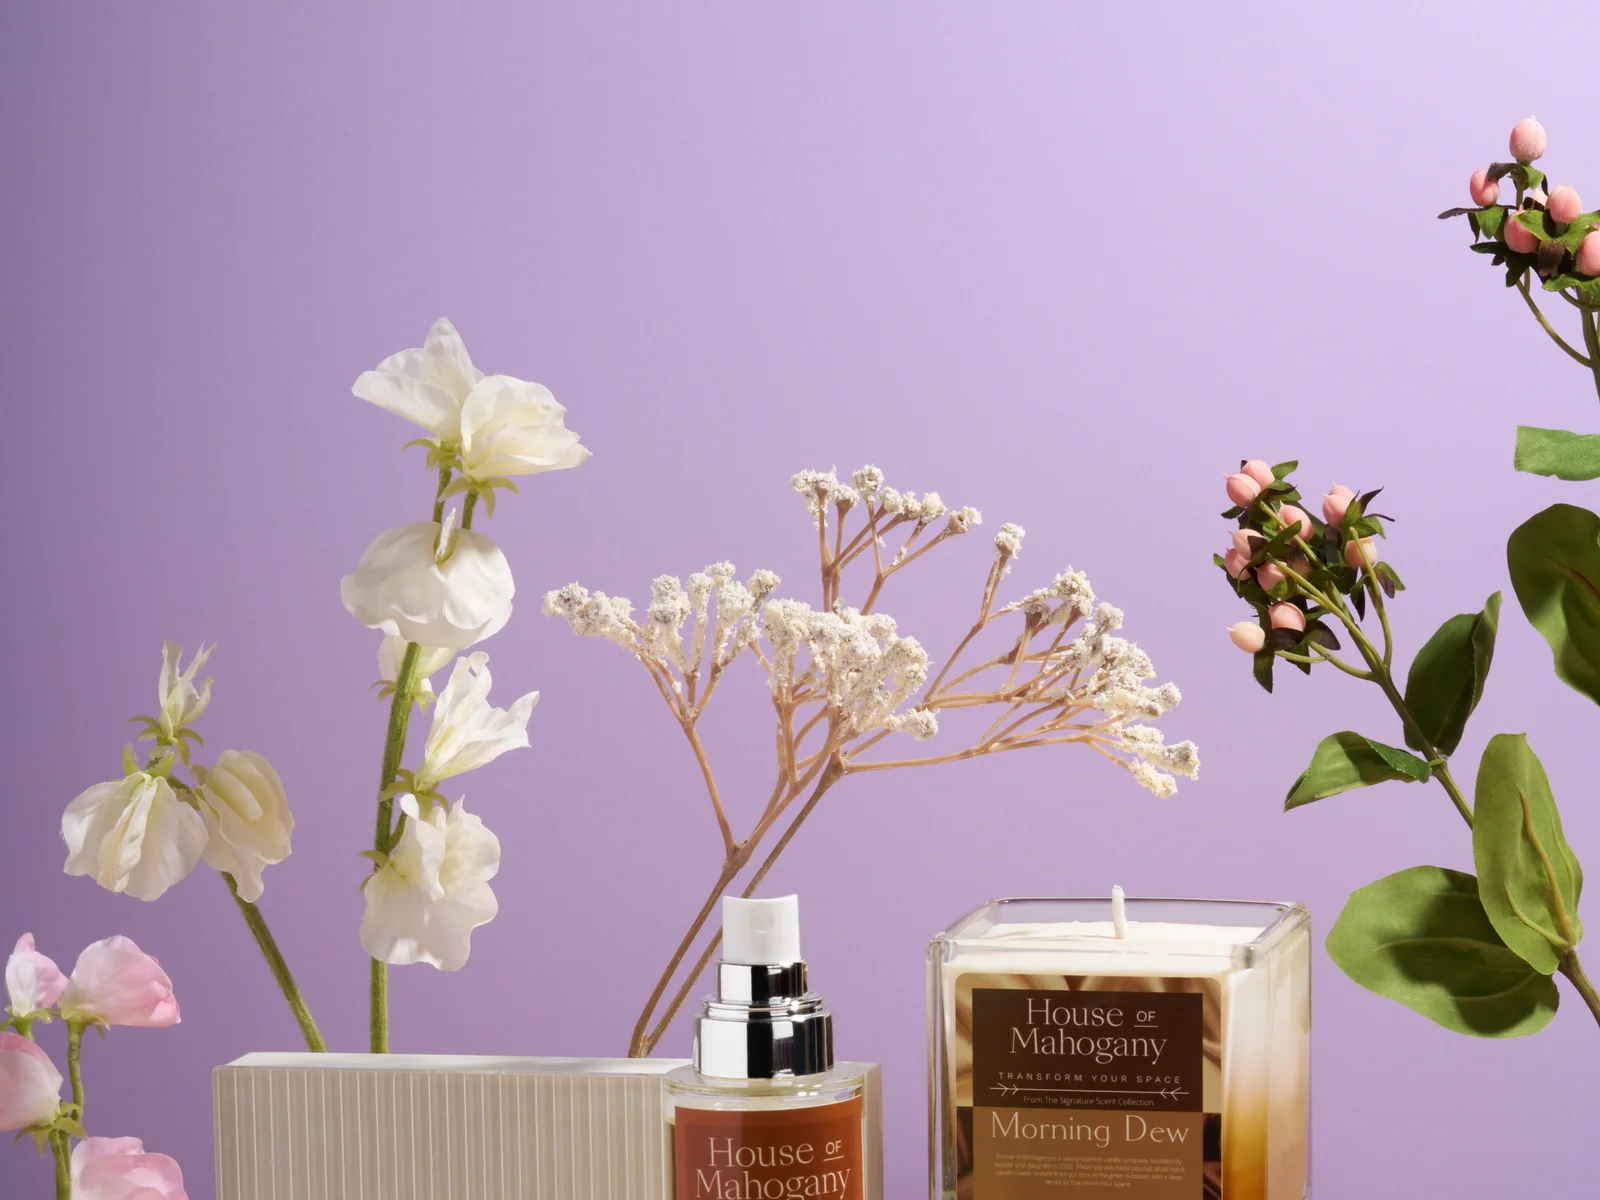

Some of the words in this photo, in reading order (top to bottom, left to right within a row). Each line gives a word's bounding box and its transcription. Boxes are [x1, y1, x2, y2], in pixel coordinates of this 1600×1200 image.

[1025, 998, 1125, 1027] House
[1136, 1010, 1156, 1023] OF
[1009, 1027, 1169, 1066] Mahogany
[999, 1072, 1084, 1083] TRANSFORM
[1091, 1074, 1128, 1083] YOUR
[1136, 1075, 1181, 1084] SPACE
[1023, 1096, 1043, 1104] From
[1044, 1096, 1058, 1104] The
[1059, 1097, 1095, 1106] Signature
[1117, 1098, 1155, 1107] Collection
[991, 1111, 1110, 1148] Morning
[1125, 1114, 1189, 1144] Dew
[708, 1137, 815, 1168] House
[825, 1140, 842, 1155] OF
